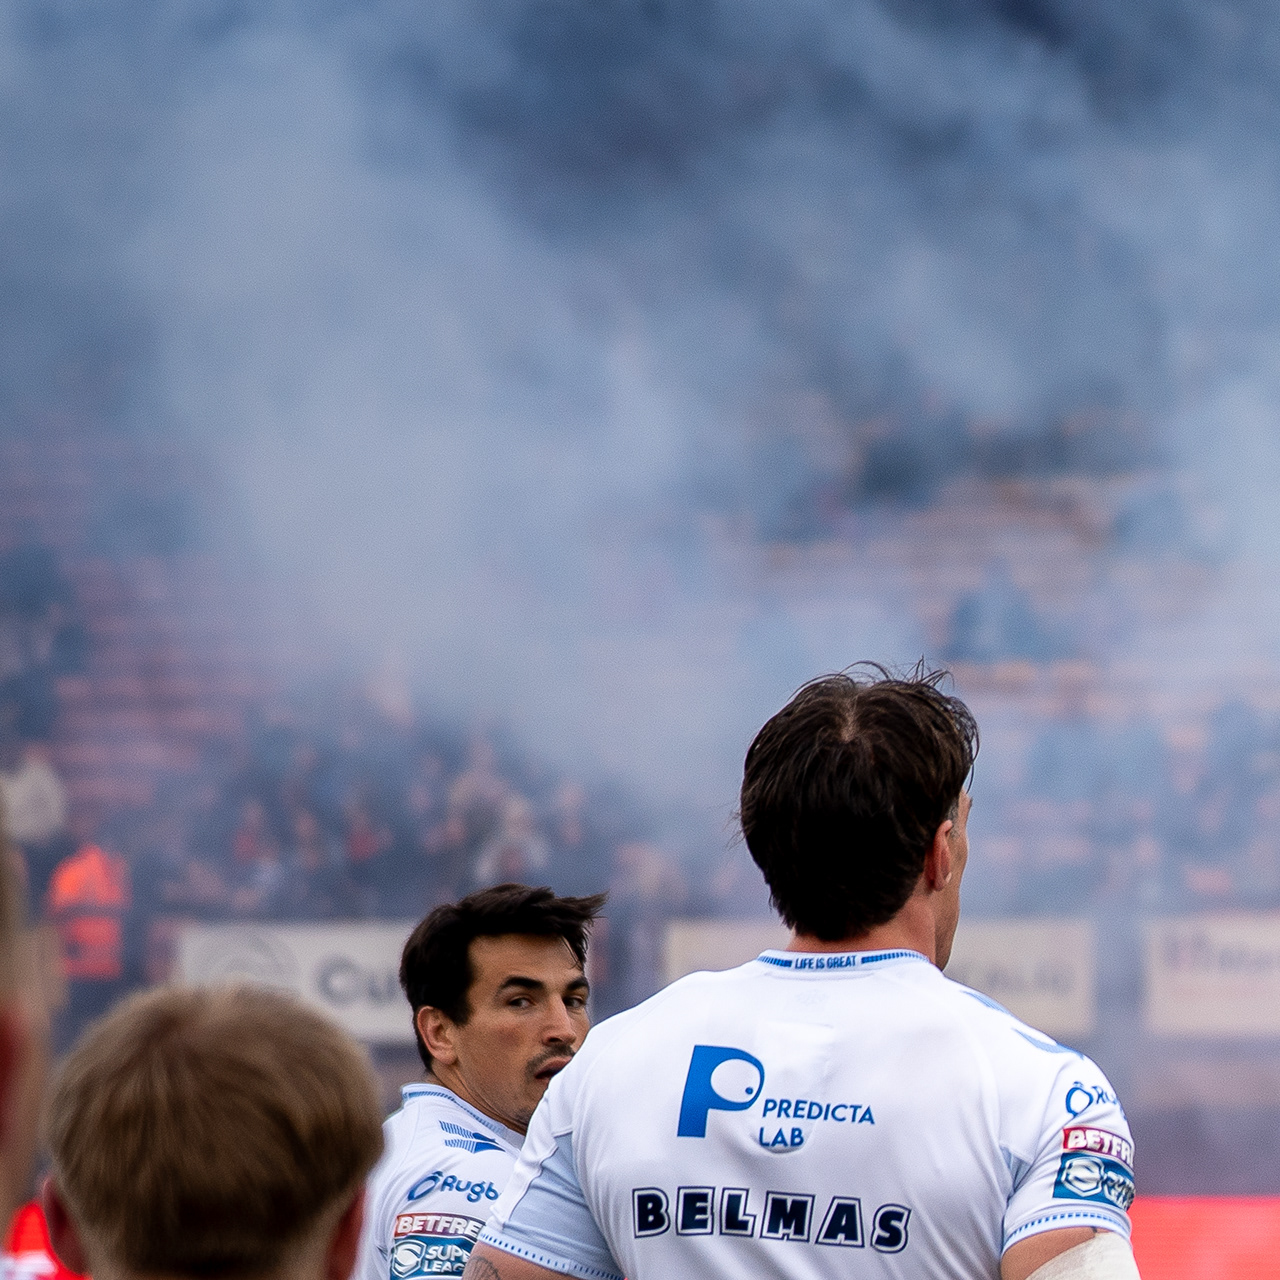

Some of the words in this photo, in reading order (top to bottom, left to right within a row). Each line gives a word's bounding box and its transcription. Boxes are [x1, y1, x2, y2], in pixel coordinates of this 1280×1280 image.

[795, 957, 814, 969] LIFE
[816, 957, 825, 969] IS
[827, 955, 857, 969] GREAT
[761, 1098, 876, 1126] PREDICTA
[758, 1126, 805, 1149] LAB
[398, 1216, 483, 1237] BETFRE
[632, 1186, 911, 1253] BELMAS
[423, 1261, 465, 1273] LEAG
